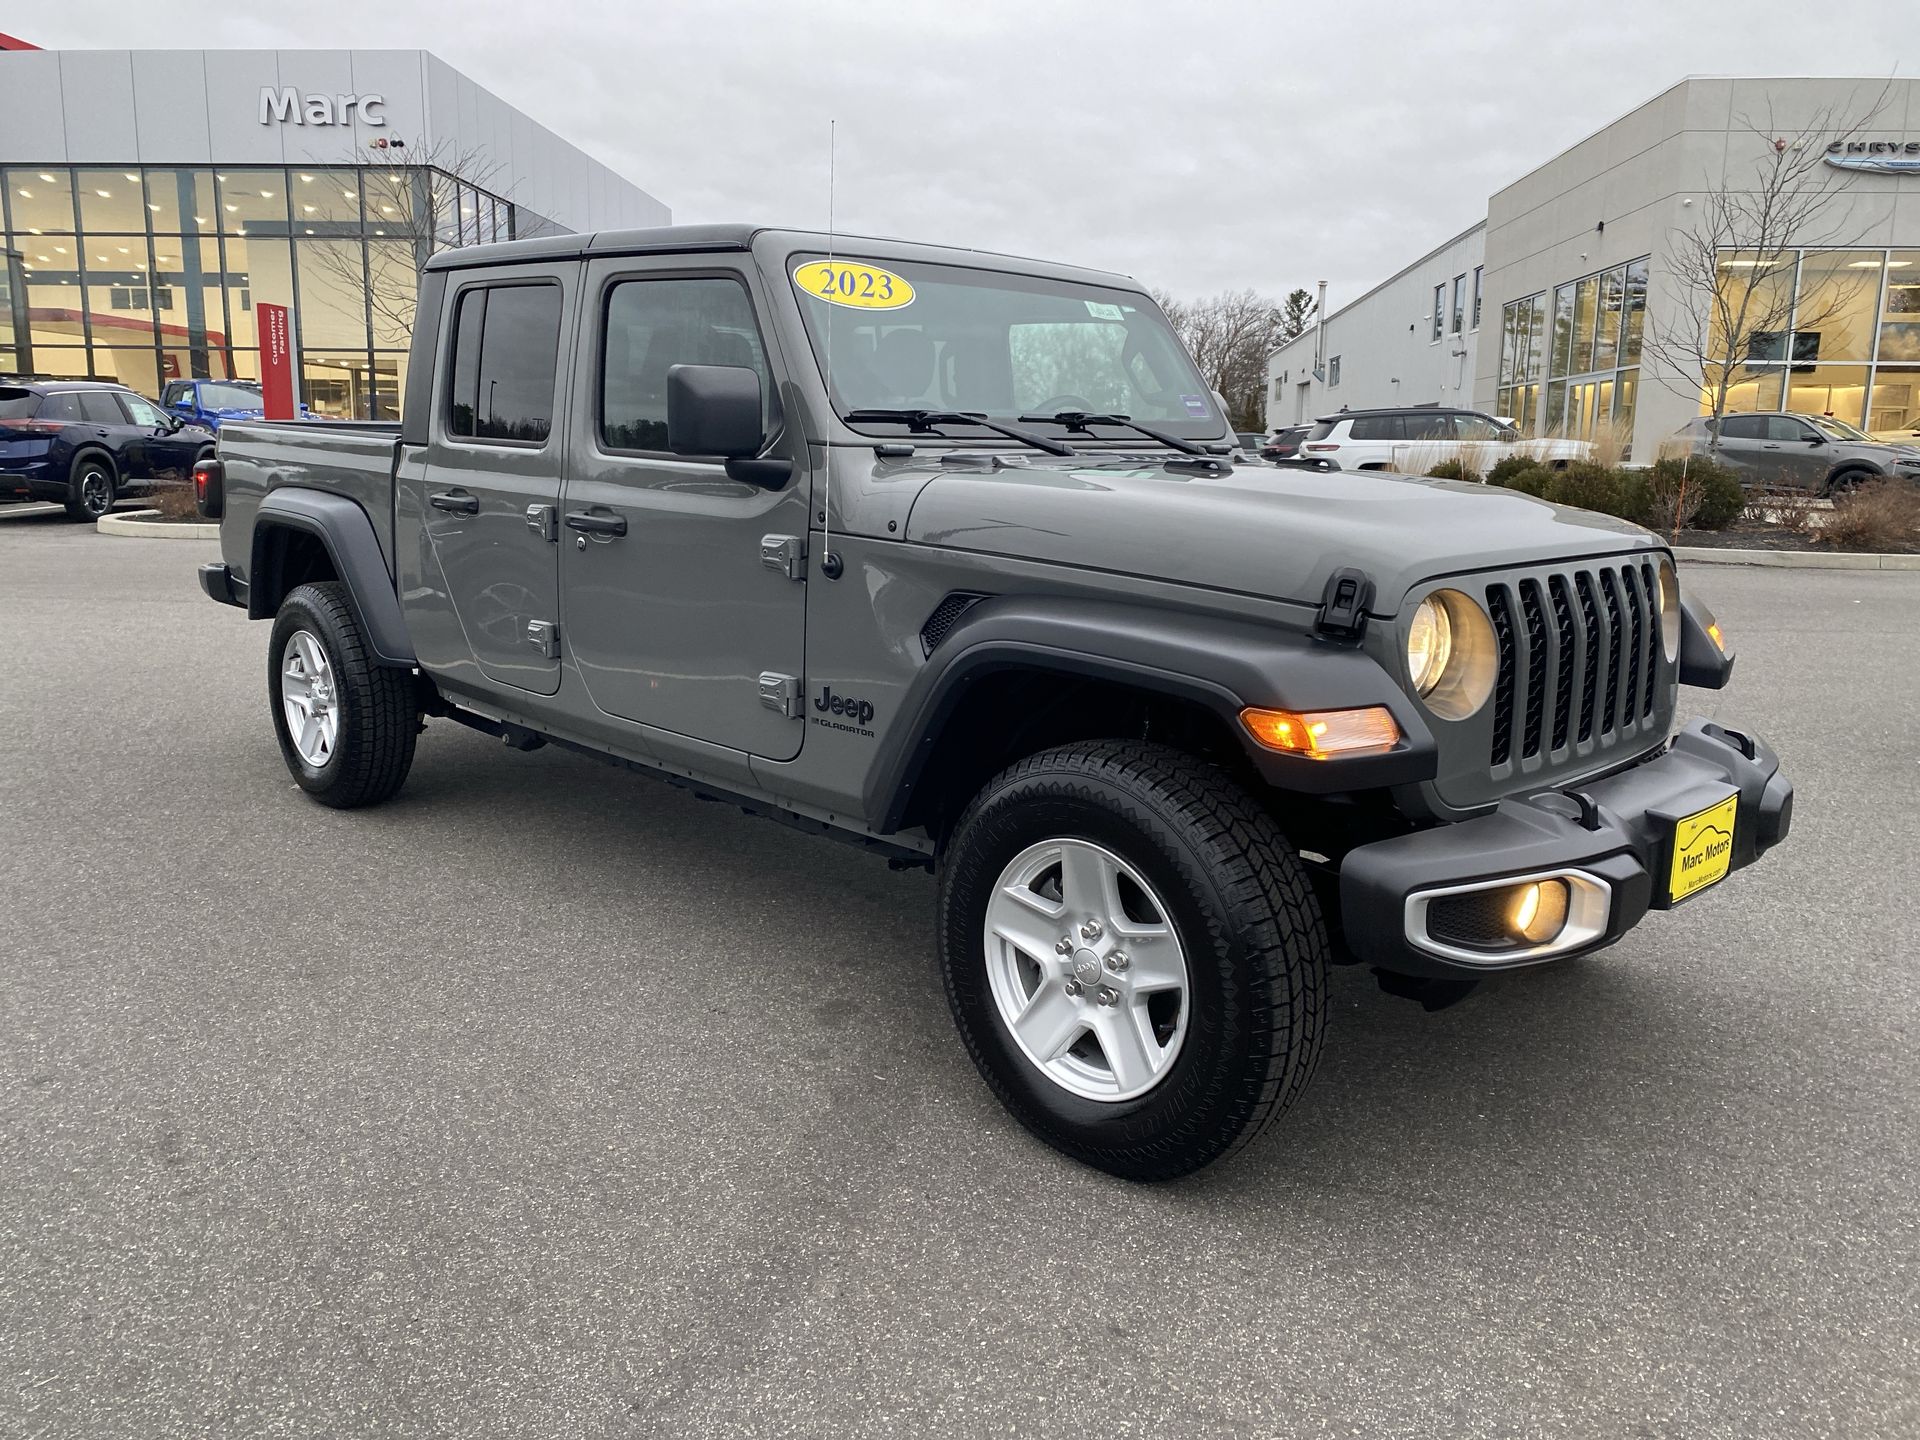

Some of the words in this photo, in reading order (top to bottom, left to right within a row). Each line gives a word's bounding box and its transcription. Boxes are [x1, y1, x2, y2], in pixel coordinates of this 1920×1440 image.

[258, 86, 384, 126] Marc
[1827, 141, 1920, 154] CHRYS
[820, 269, 893, 300] 2023
[270, 309, 278, 365] Customer
[814, 686, 874, 726] Jeep
[820, 719, 875, 738] GLADIATOR
[1681, 852, 1703, 873] Marc
[1705, 838, 1729, 861] Motors
